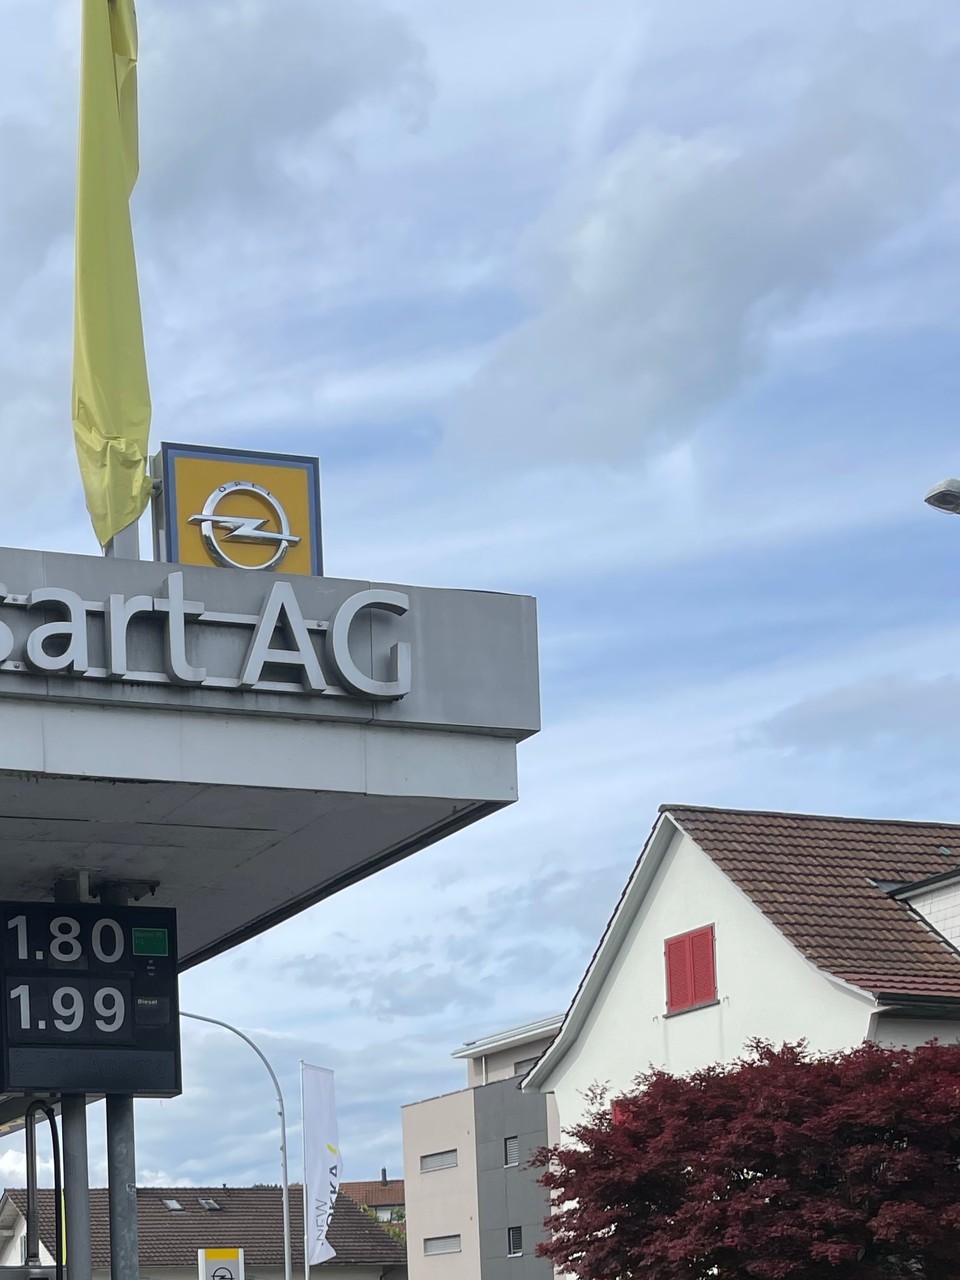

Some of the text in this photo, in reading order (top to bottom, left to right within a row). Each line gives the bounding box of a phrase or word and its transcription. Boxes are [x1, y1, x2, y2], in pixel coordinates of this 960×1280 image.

[238, 580, 412, 701] AG
[7, 915, 125, 963] 1.80
[10, 984, 126, 1032] 1.99
[315, 1198, 328, 1242] NEW
[323, 1164, 338, 1245] OKKA
